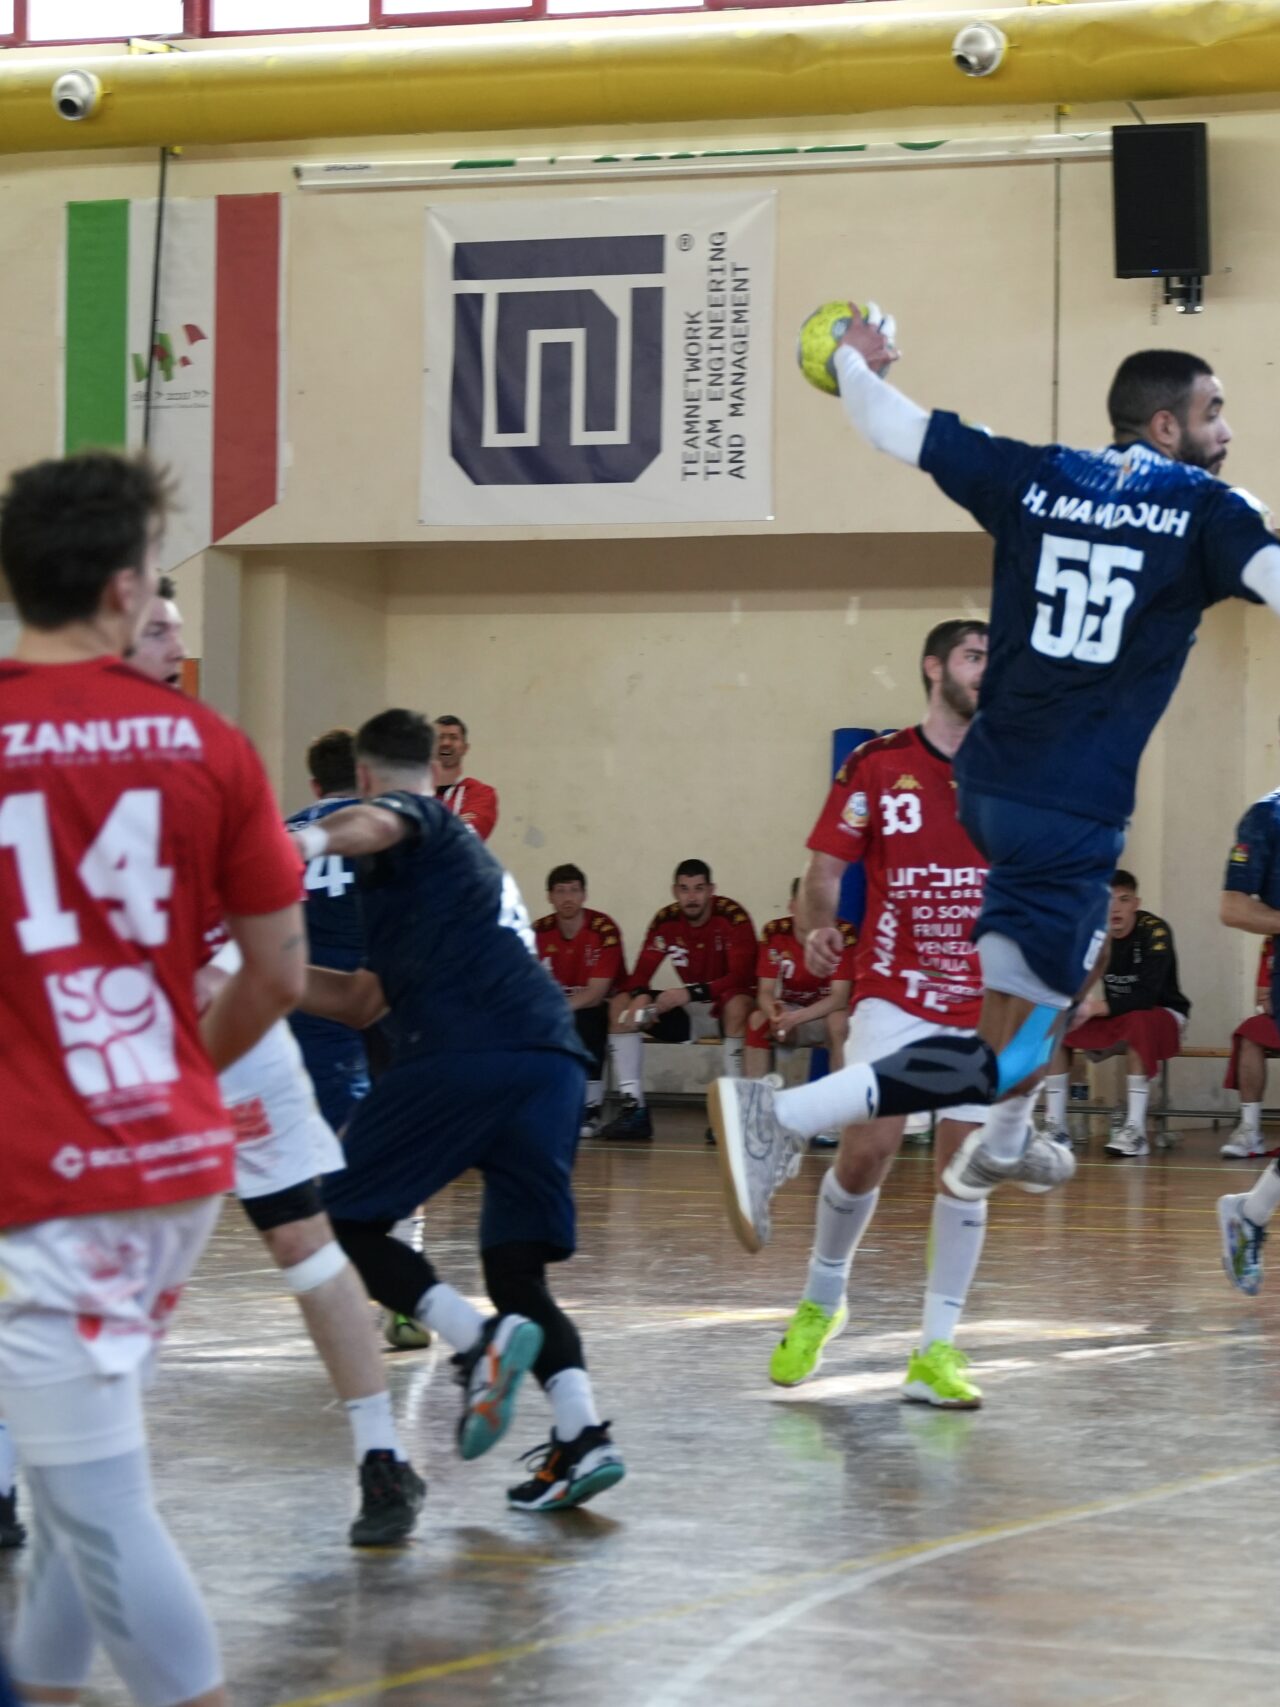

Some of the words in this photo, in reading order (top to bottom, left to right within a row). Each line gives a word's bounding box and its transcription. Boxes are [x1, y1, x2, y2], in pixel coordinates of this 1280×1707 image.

[706, 231, 728, 401] ENGINEERING
[728, 262, 750, 417] MANAGEMENT
[682, 311, 702, 481] TEAMNETWORK
[704, 419, 722, 481] TEAM
[728, 434, 746, 479] AND
[1022, 482, 1048, 517] H.
[1030, 533, 1144, 664] 55
[1, 717, 202, 755] ZANUTTA
[880, 793, 922, 835] 33
[0, 789, 174, 955] 14
